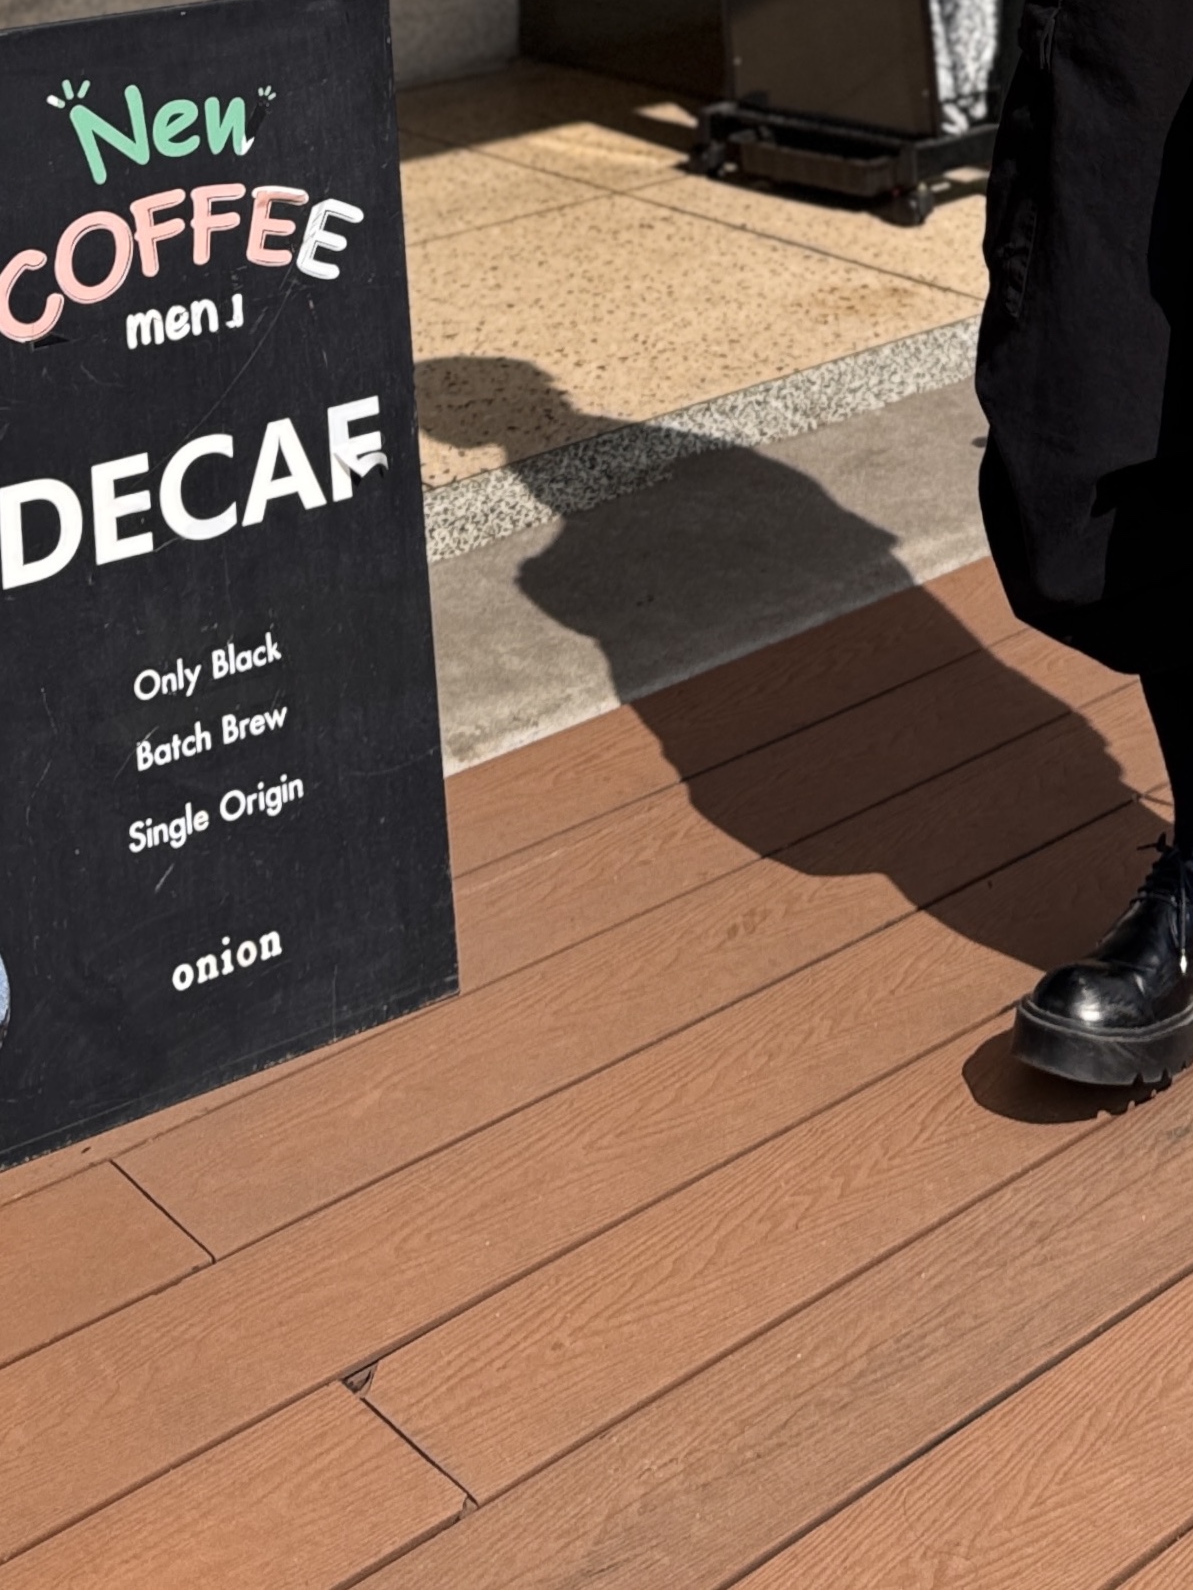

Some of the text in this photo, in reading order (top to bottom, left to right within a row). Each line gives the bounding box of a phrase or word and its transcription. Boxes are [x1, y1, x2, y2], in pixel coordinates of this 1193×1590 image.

[0, 182, 365, 342] COFFEE
[0, 395, 389, 590] DECAF
[133, 631, 282, 701] Only Black
[136, 706, 288, 772] Batch Brew
[128, 773, 304, 853] Single Origin
[171, 930, 282, 991] onion
